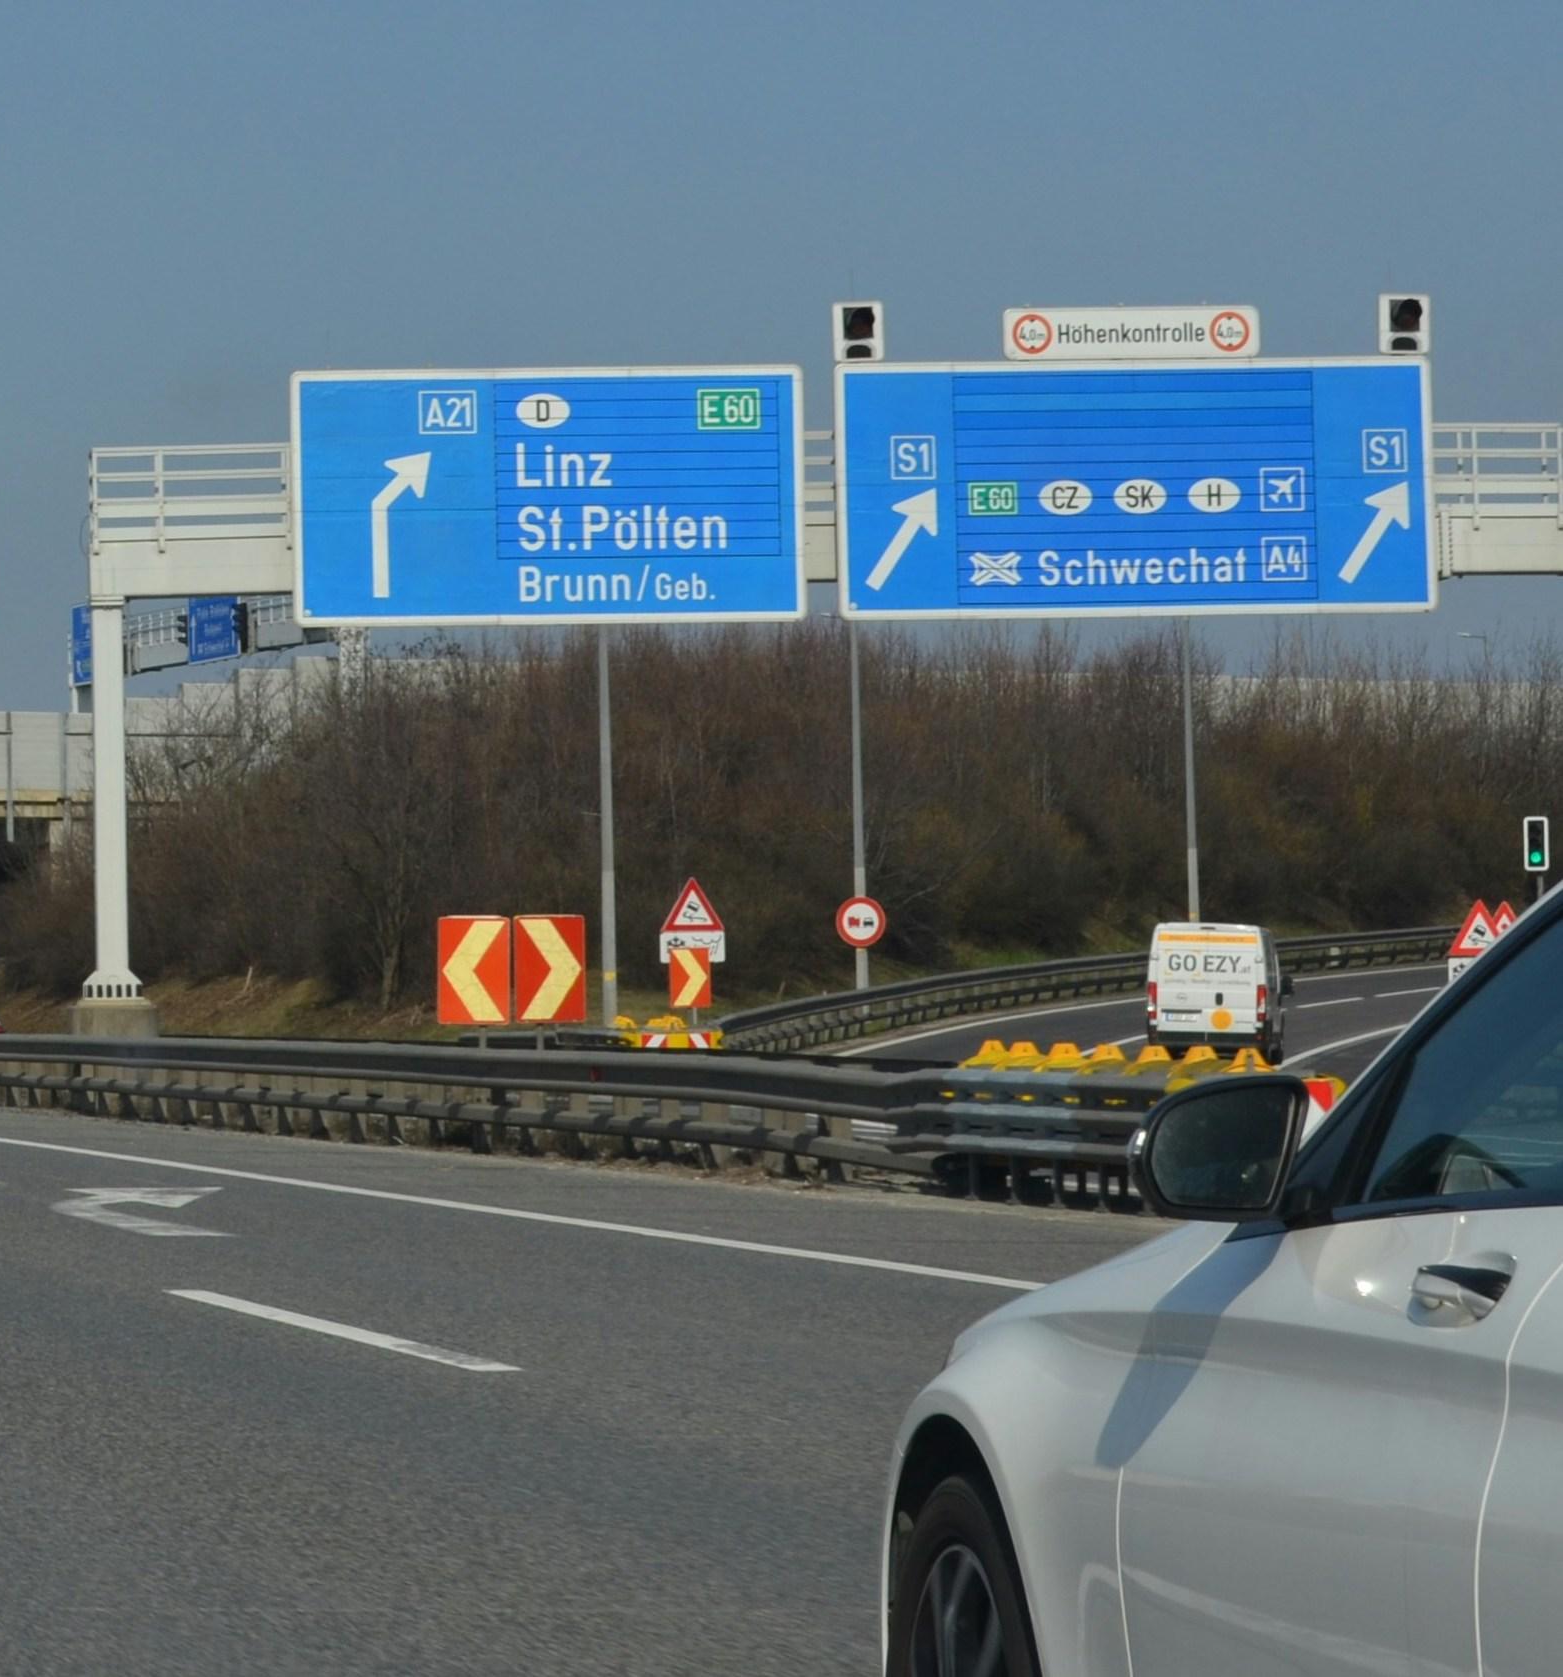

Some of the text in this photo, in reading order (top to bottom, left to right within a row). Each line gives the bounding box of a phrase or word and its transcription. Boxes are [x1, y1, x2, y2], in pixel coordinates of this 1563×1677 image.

[1057, 322, 1206, 344] Höhenkontrolle
[424, 397, 471, 428] A21
[536, 399, 550, 422] D
[897, 442, 929, 473] S1
[1369, 435, 1400, 466] S1
[515, 442, 613, 488] Linz
[1051, 486, 1079, 509] CZ
[1125, 484, 1153, 508] SK
[1206, 484, 1221, 507] H
[1038, 547, 1246, 586] Schwechat
[1267, 545, 1302, 573] A4
[1168, 953, 1197, 972] GO
